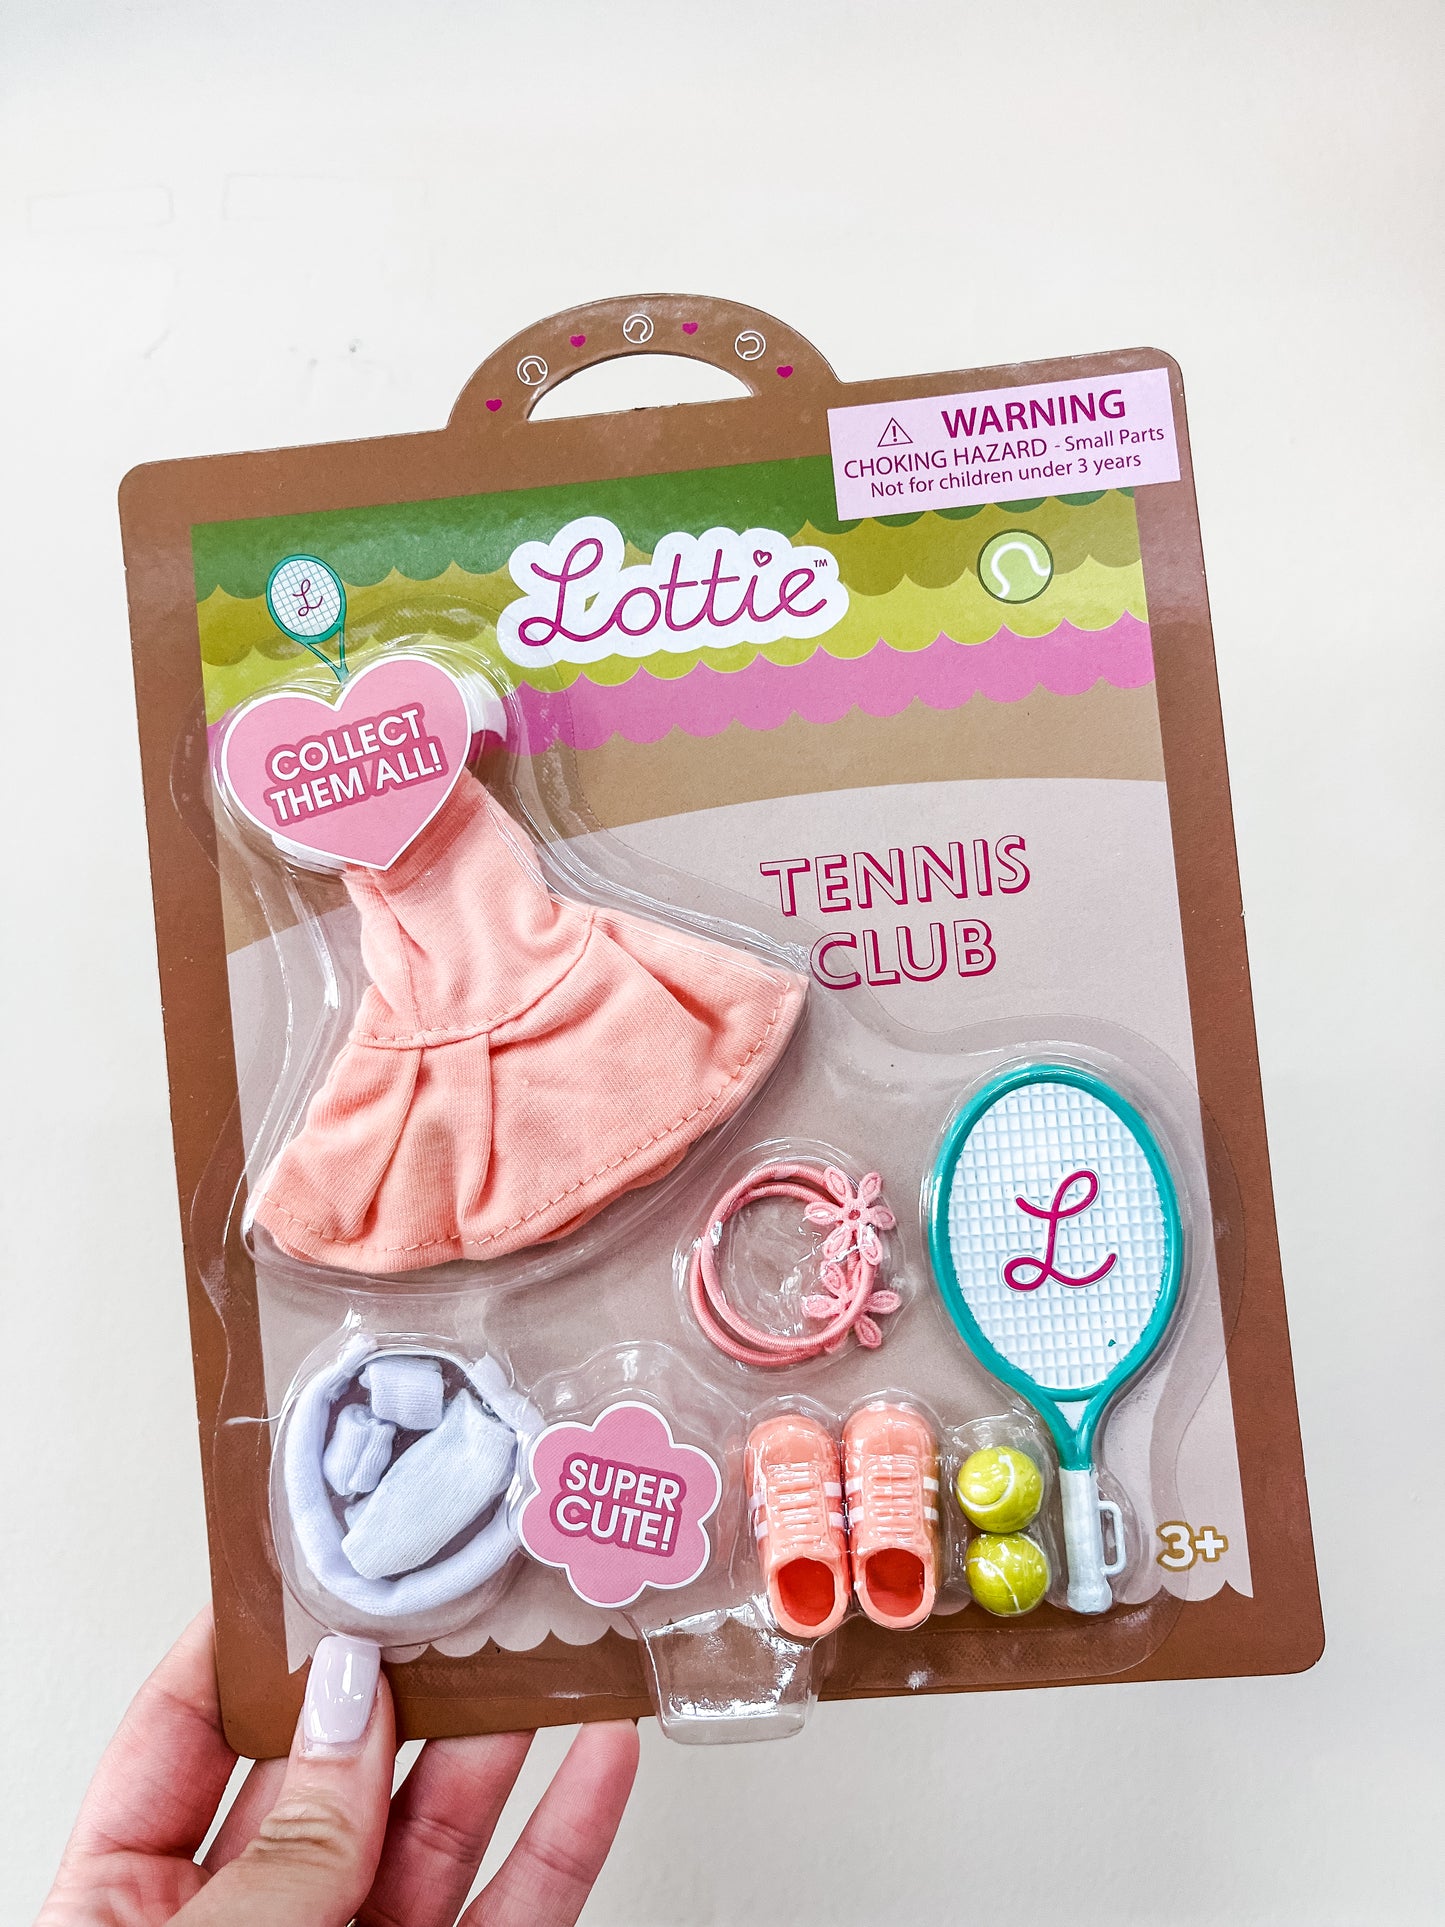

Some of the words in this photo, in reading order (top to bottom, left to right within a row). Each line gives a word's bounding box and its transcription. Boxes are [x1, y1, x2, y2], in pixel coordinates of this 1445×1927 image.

[941, 389, 1126, 438] WARNING
[844, 450, 948, 479] CHOKING
[953, 438, 1047, 467] HAZARD
[1065, 429, 1114, 452] Small
[1119, 426, 1165, 445] Parts
[871, 482, 904, 498] Not
[909, 476, 935, 494] for
[939, 467, 1013, 491] children
[1018, 458, 1073, 481] under
[1078, 458, 1088, 474] 3
[1093, 454, 1142, 476] years
[518, 537, 828, 647] Lottie
[270, 708, 420, 782] COLLECT
[269, 767, 366, 821] THEM
[376, 742, 444, 790] ALL!
[759, 834, 1031, 917] TENNIS
[809, 918, 997, 990] CLUB
[1003, 1168, 1117, 1292] L
[565, 1459, 681, 1512] SUPER
[555, 1495, 676, 1551] CUTE!
[1158, 1523, 1227, 1570] 3+
